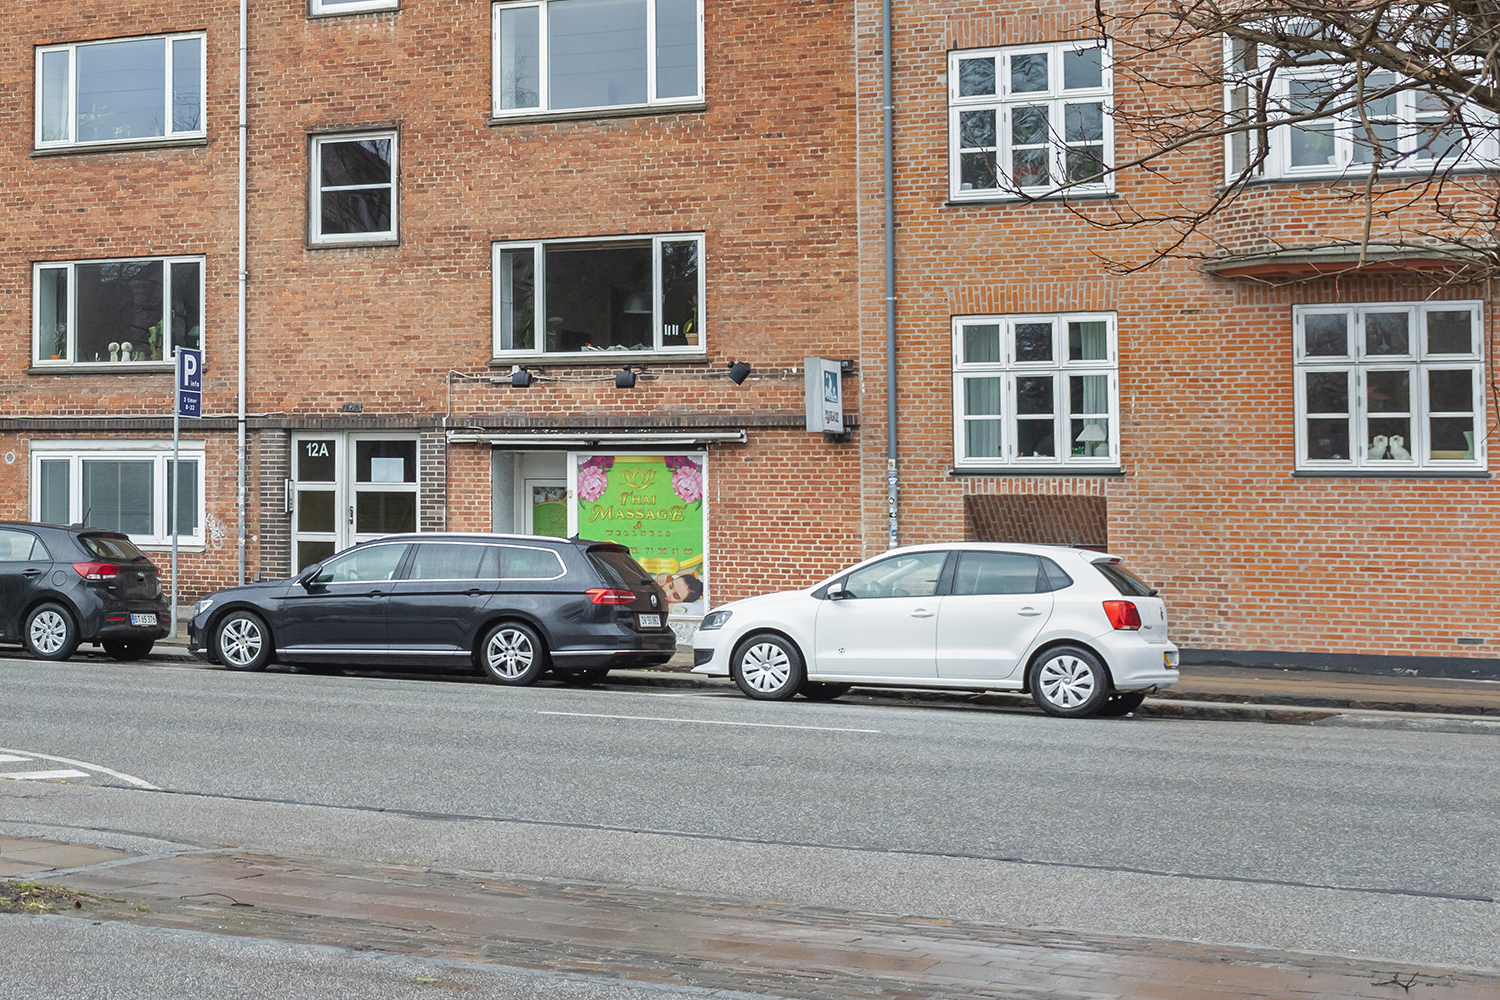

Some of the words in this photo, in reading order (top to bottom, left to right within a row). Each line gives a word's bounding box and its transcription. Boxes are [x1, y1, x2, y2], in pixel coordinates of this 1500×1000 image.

[184, 354, 197, 386] P
[306, 442, 329, 457] 12A
[619, 491, 657, 505] THAI
[588, 504, 687, 522] MASSAGE
